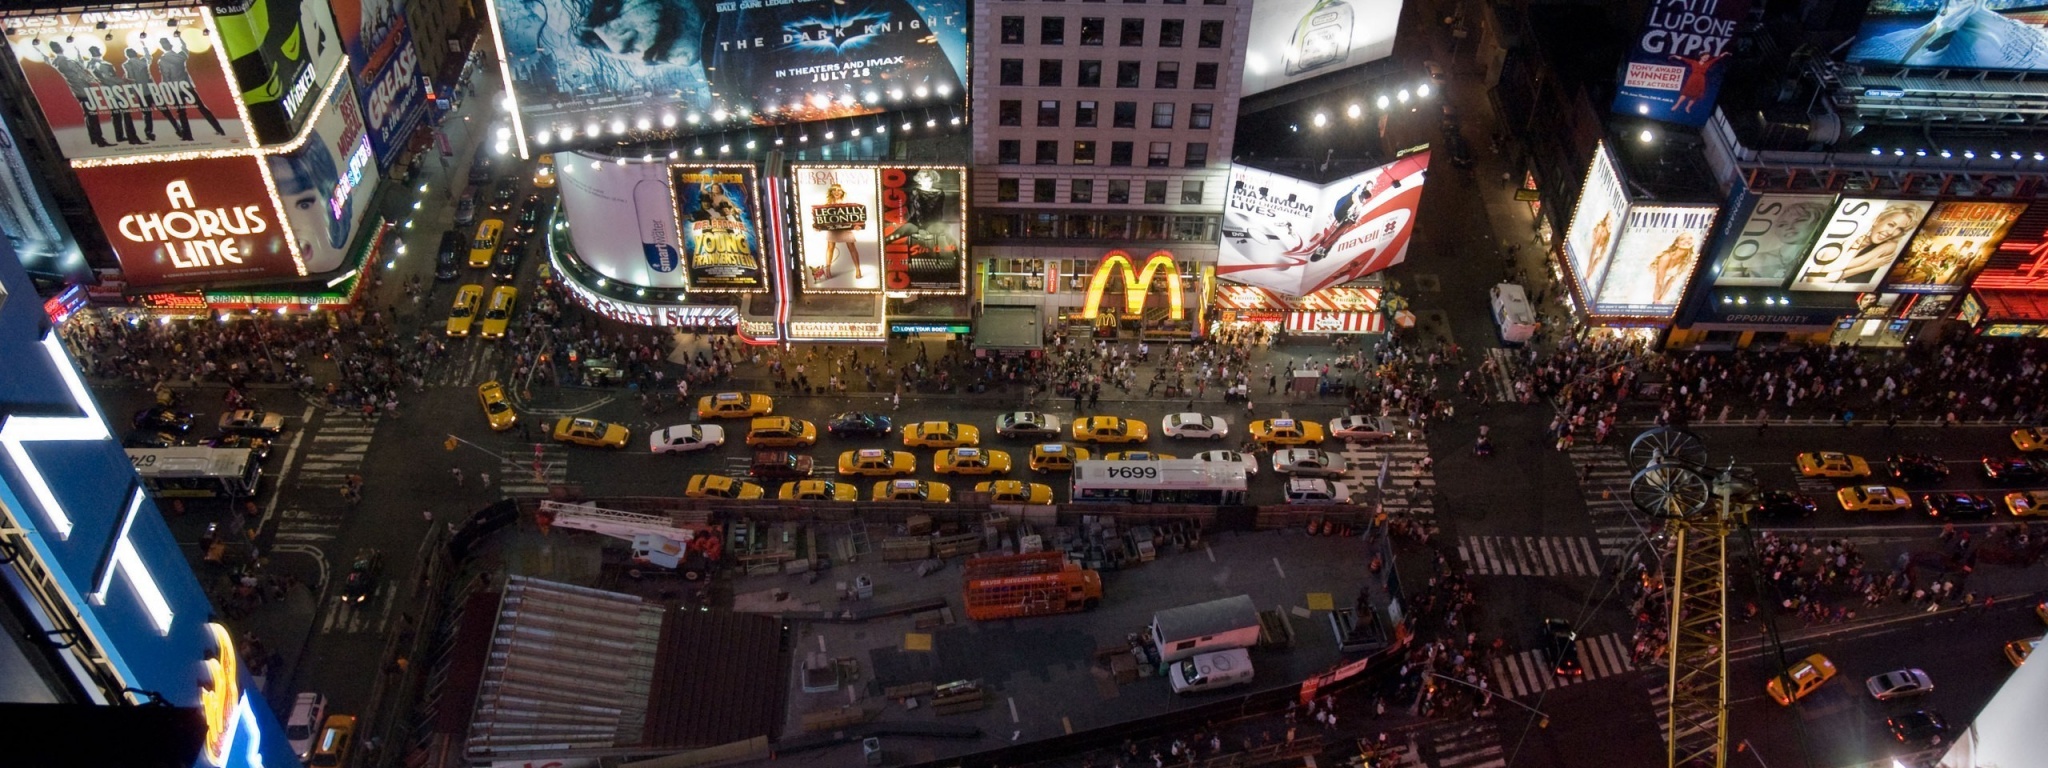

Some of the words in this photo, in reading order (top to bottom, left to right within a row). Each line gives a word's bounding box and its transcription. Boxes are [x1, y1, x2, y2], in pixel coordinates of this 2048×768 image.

[716, 4, 737, 13] BALE
[740, 1, 762, 10] CAINE
[4, 14, 71, 29] BEST
[81, 6, 200, 24] MUSICAL
[61, 25, 94, 33] Tony
[720, 38, 764, 51] THE
[783, 28, 845, 44] DARK
[864, 16, 954, 34] KNIGHT
[1642, 29, 1729, 57] GYPSY
[776, 70, 786, 78] IN
[790, 63, 841, 77] THEATERS
[843, 60, 864, 70] AND
[867, 55, 904, 66] IMAX
[812, 71, 849, 83] JULY
[853, 68, 870, 78] 18
[1655, 66, 1682, 74] AWARD
[369, 41, 417, 130] GREASE
[1630, 71, 1681, 82] WINNER!
[1647, 81, 1679, 89] ACTRESS
[84, 82, 149, 112] JERSEY
[149, 81, 196, 107] BOYS
[381, 125, 390, 143] is
[389, 107, 400, 131] the
[1598, 153, 1615, 196] MAMMA
[165, 180, 196, 210] A
[1234, 188, 1314, 213] MAXIMUM
[814, 206, 866, 217] LEGALLY
[1231, 199, 1276, 218] LIVES
[1937, 203, 2021, 221] HEIGHTS
[118, 205, 267, 242] CHORUS
[693, 221, 710, 230] MEL
[816, 213, 867, 225] BLONDE
[1631, 211, 1679, 228] MAMMA
[1682, 213, 1713, 229] MIA!
[1337, 229, 1380, 252] maxell
[1721, 202, 1782, 278] TOUS
[1934, 226, 1957, 237] BEST
[1957, 227, 1995, 237] MUSICAL
[692, 231, 751, 255] YOUNG
[1799, 201, 1870, 283] TOUS
[165, 237, 243, 269] LINE
[692, 253, 758, 268] FRANKENSTEIN
[165, 295, 202, 306] STEAKS
[213, 295, 246, 304] sbarro
[260, 294, 292, 304] sbarro
[307, 295, 340, 304] sbarro
[1726, 314, 1809, 322] OPPORTUNITY
[838, 324, 879, 332] BLONDE
[1107, 466, 1157, 478] 6694
